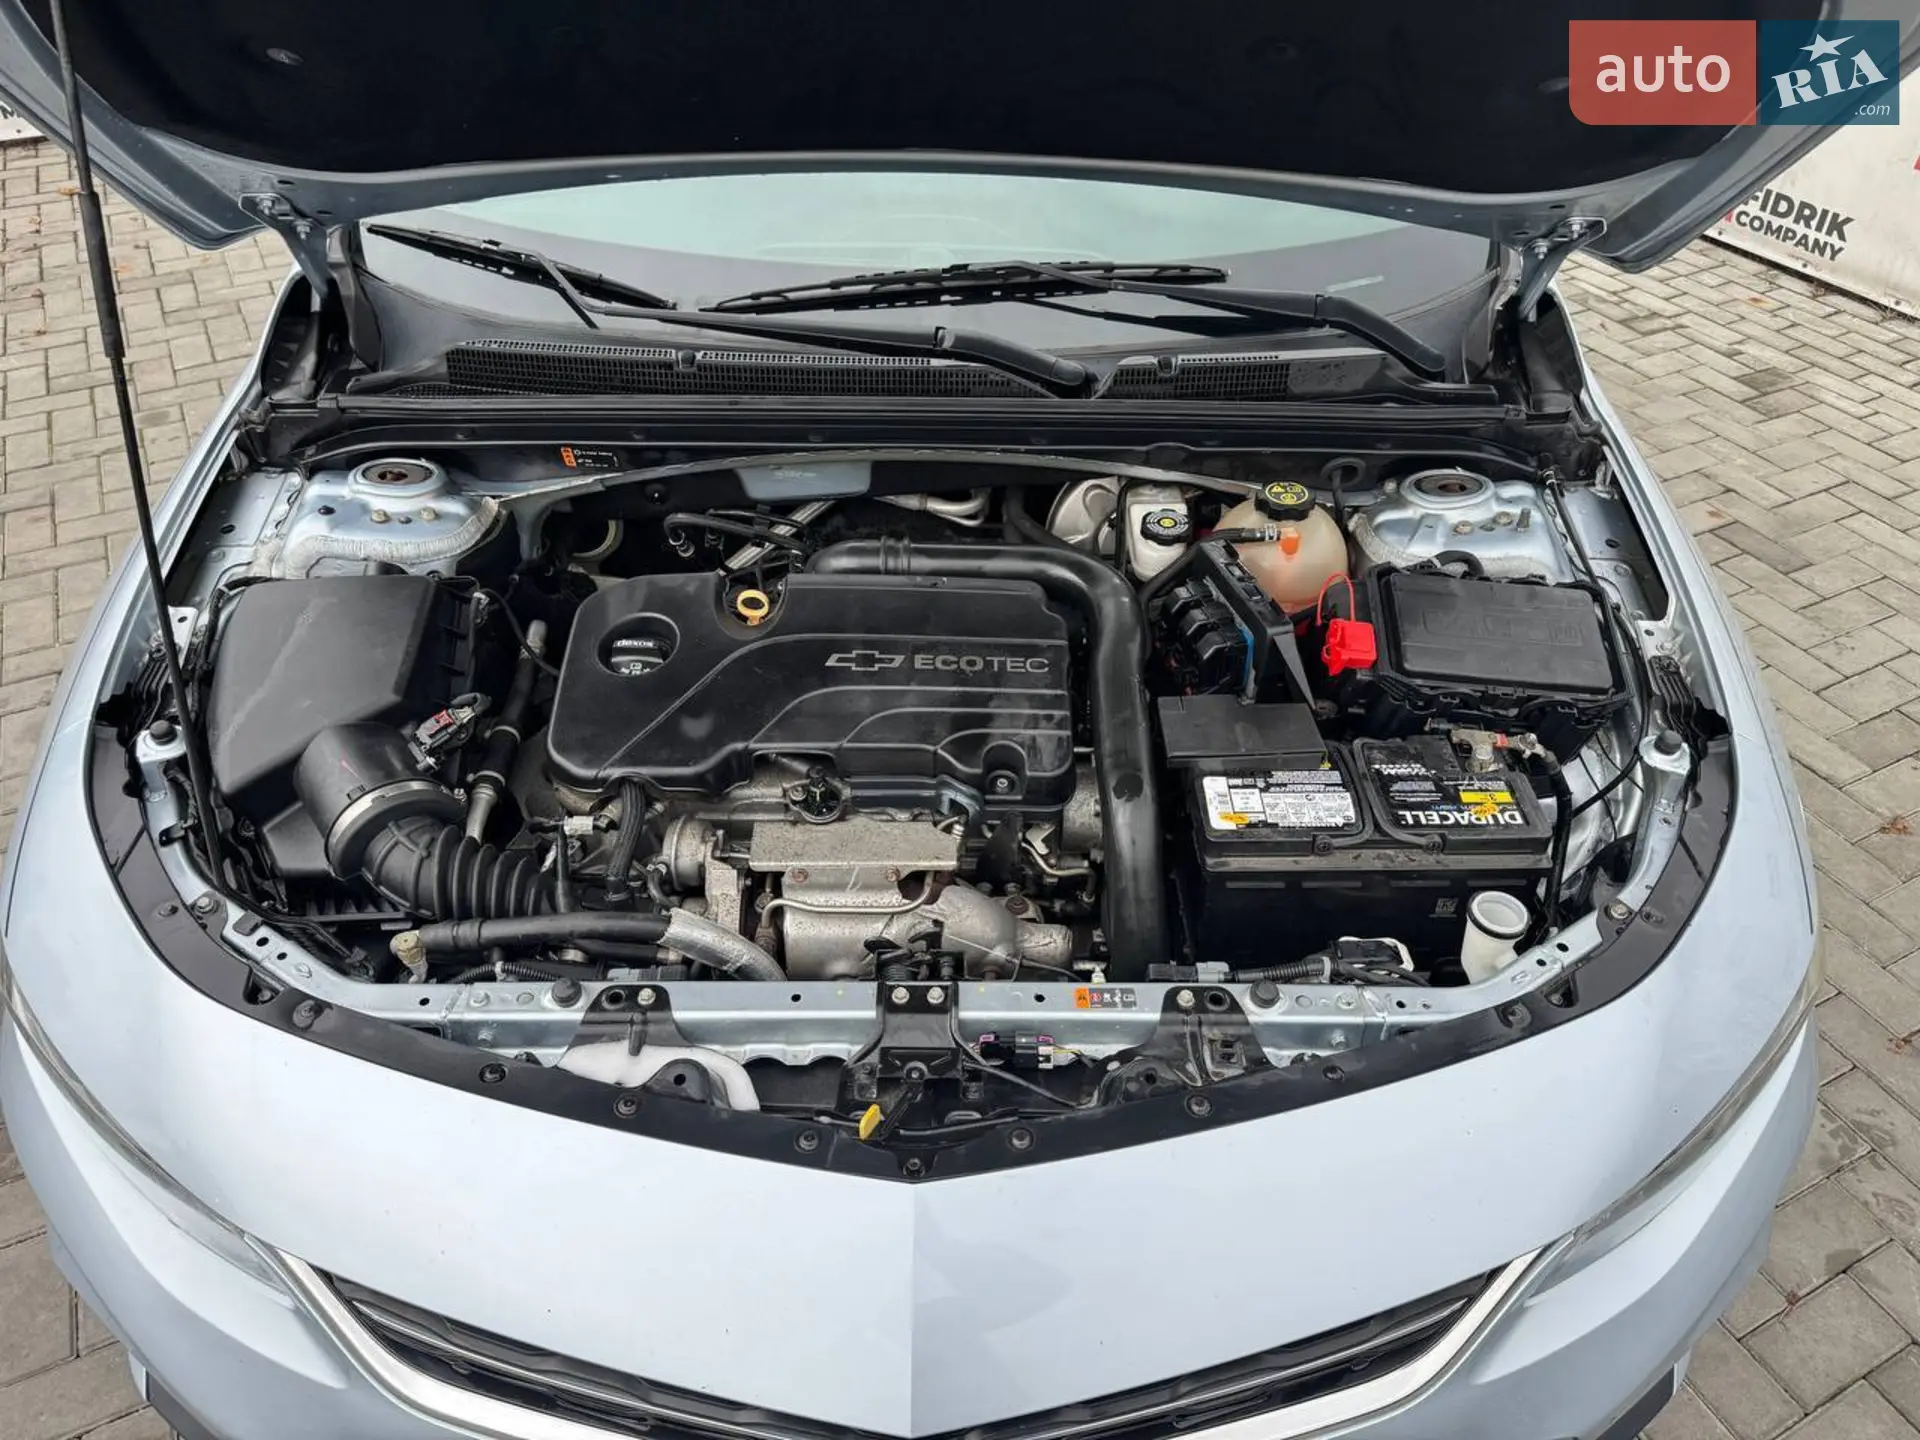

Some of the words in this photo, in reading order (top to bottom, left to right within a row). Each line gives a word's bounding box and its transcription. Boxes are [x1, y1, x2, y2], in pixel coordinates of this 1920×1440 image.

[1735, 210, 1845, 262] COMPANY
[914, 654, 1049, 673] ECOTEC
[1398, 810, 1524, 825] DURACELL
